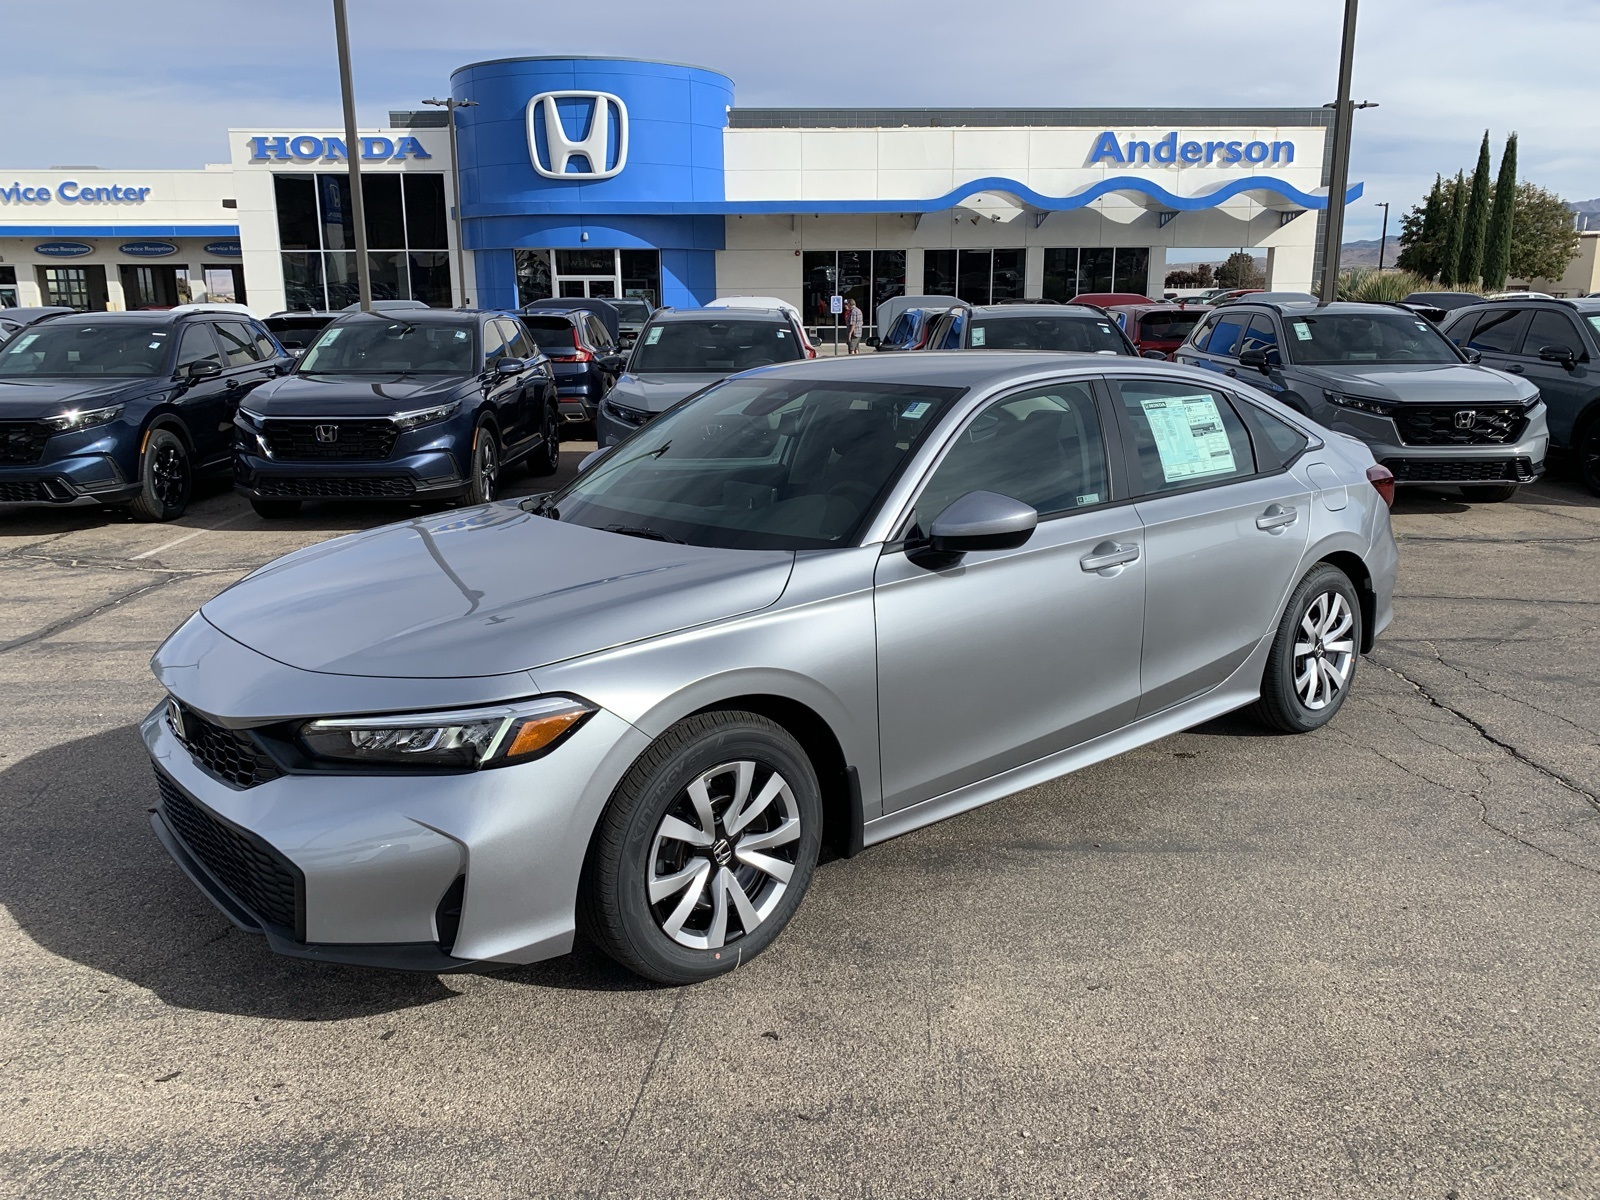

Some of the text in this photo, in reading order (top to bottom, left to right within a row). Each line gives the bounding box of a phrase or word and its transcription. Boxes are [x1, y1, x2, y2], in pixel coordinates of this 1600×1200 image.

[252, 136, 431, 159] HONDA
[1091, 132, 1295, 163] Anderson
[58, 181, 151, 202] Center
